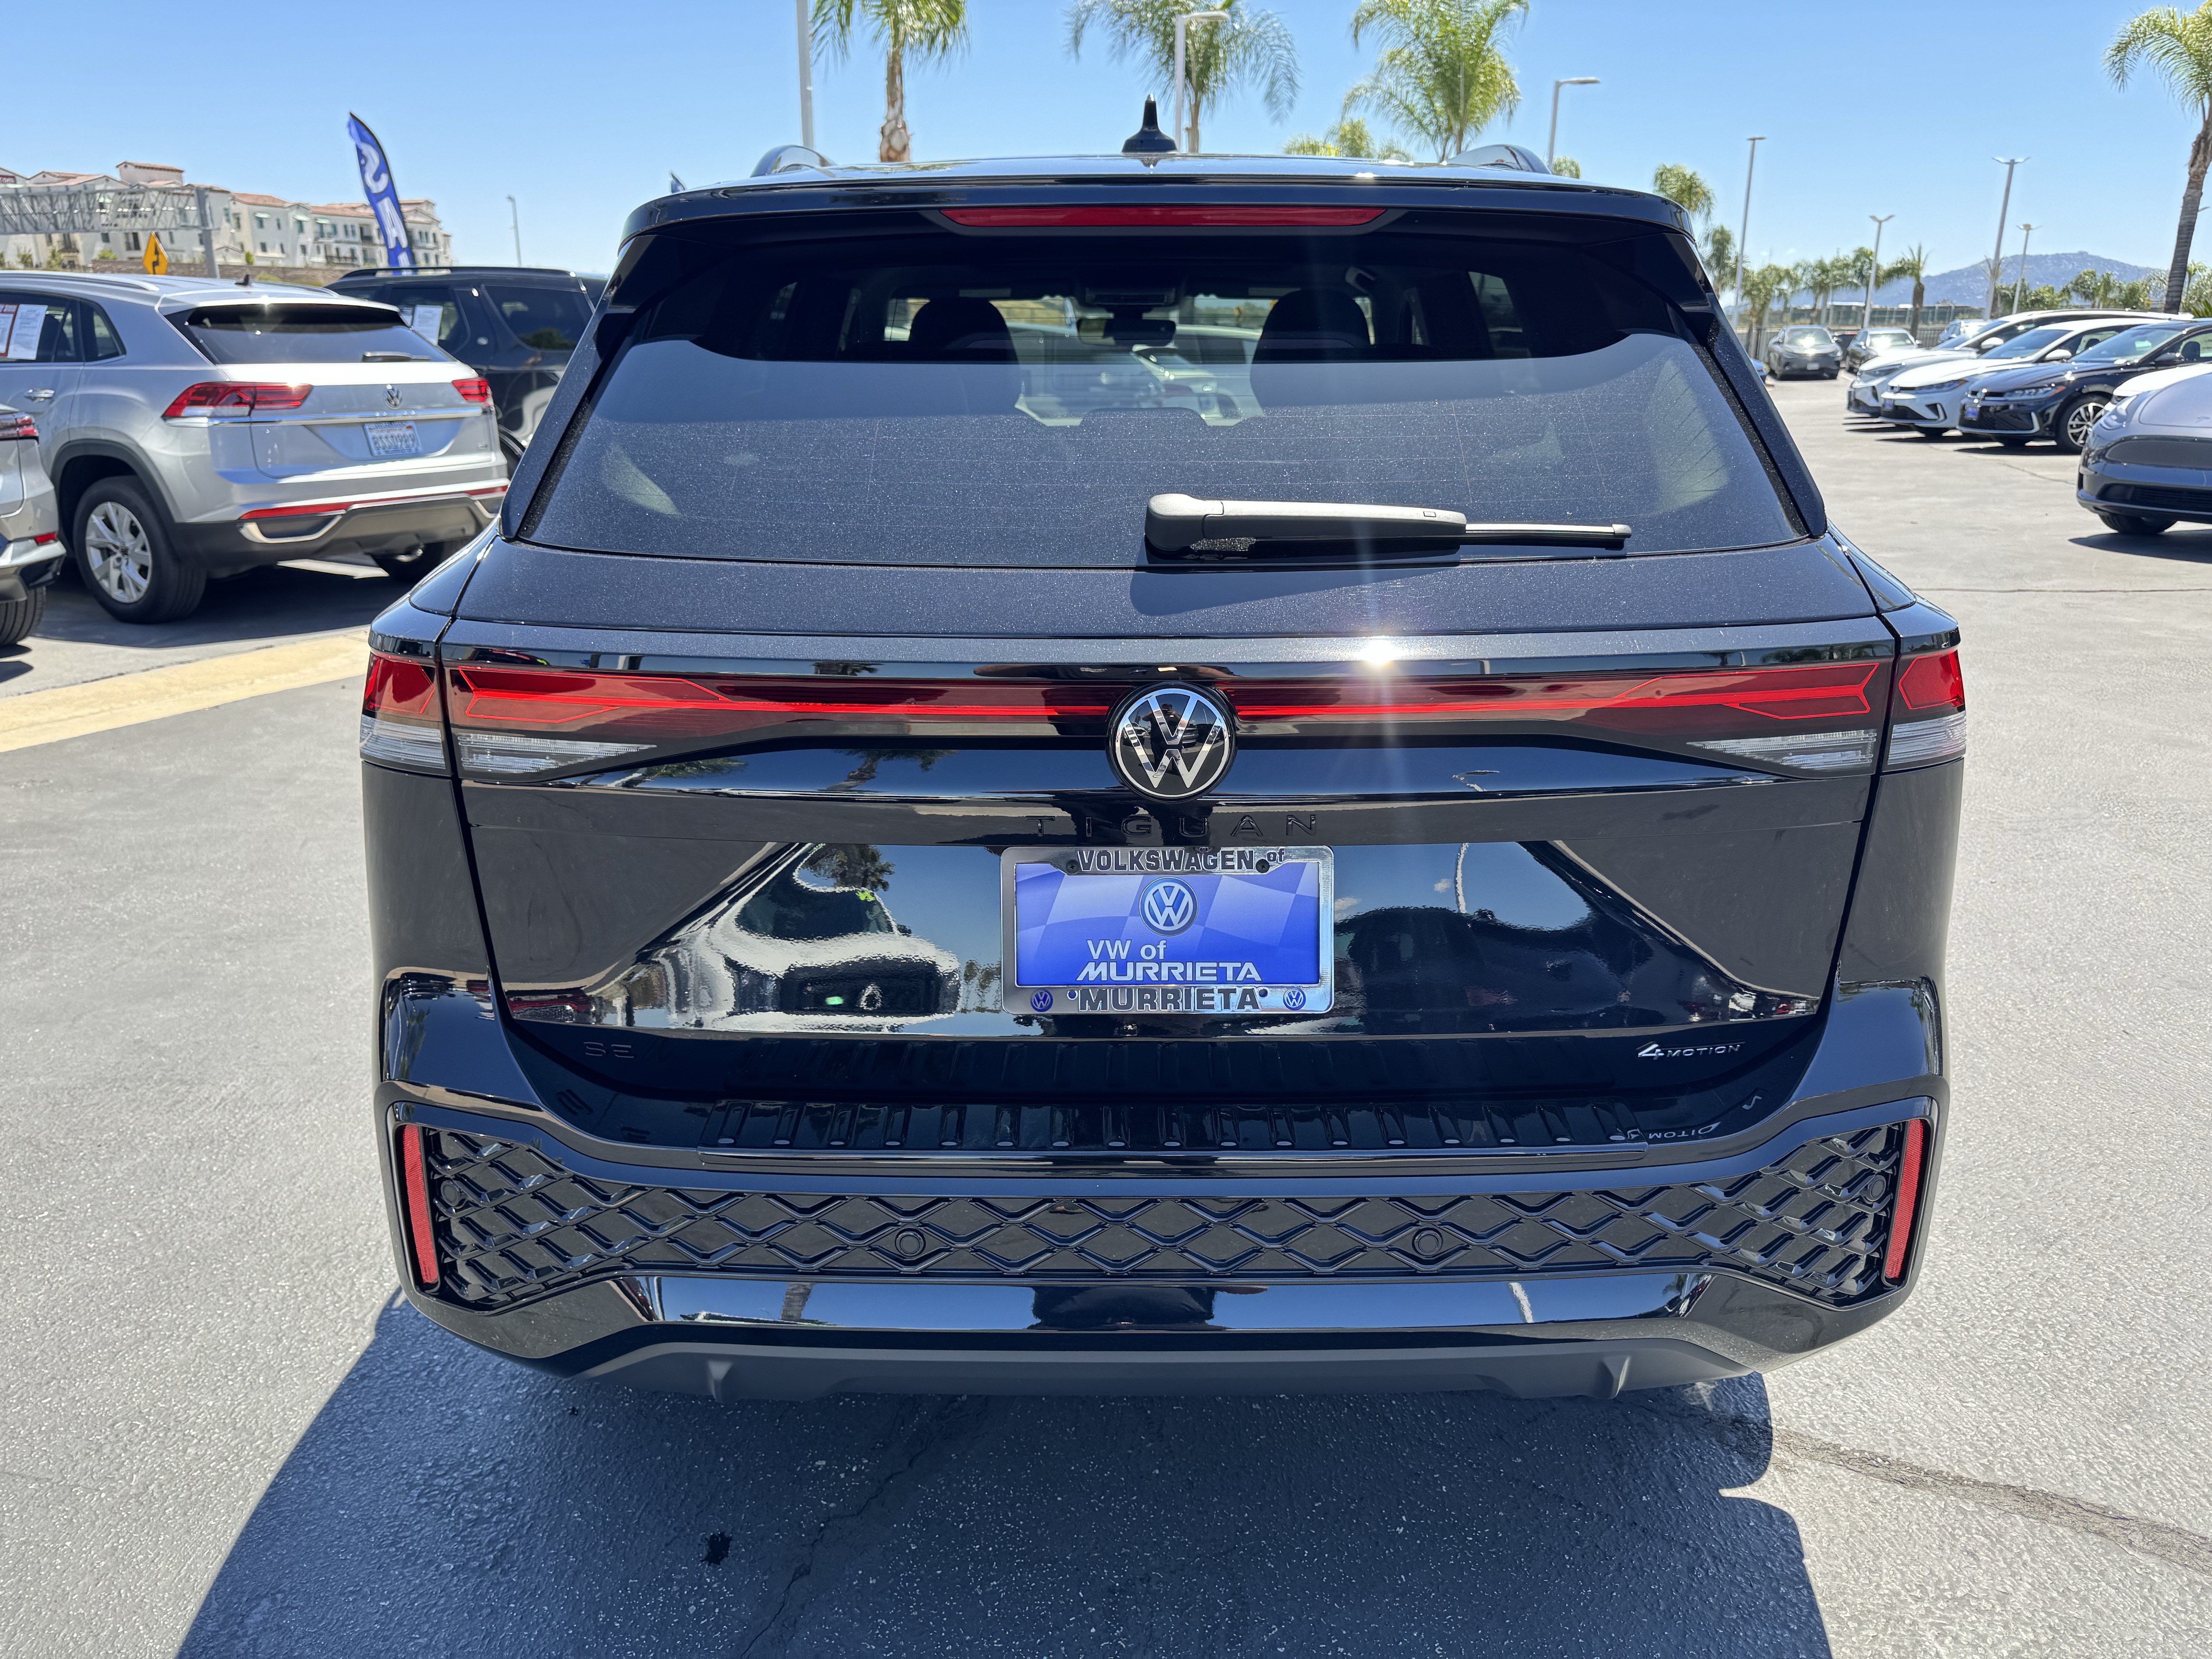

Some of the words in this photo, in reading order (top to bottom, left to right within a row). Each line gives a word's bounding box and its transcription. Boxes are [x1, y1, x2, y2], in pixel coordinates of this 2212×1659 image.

[1026, 814, 1317, 837] TIGUAN
[1077, 849, 1255, 872] VOLKSWAGEN
[1266, 848, 1285, 864] of
[1087, 939, 1132, 960] VW
[1140, 939, 1167, 960] of
[1076, 962, 1262, 981] MURRIETA
[1079, 986, 1262, 1012] MURRIETA
[583, 1042, 635, 1058] SE
[1637, 1041, 1741, 1060] 4MOTION
